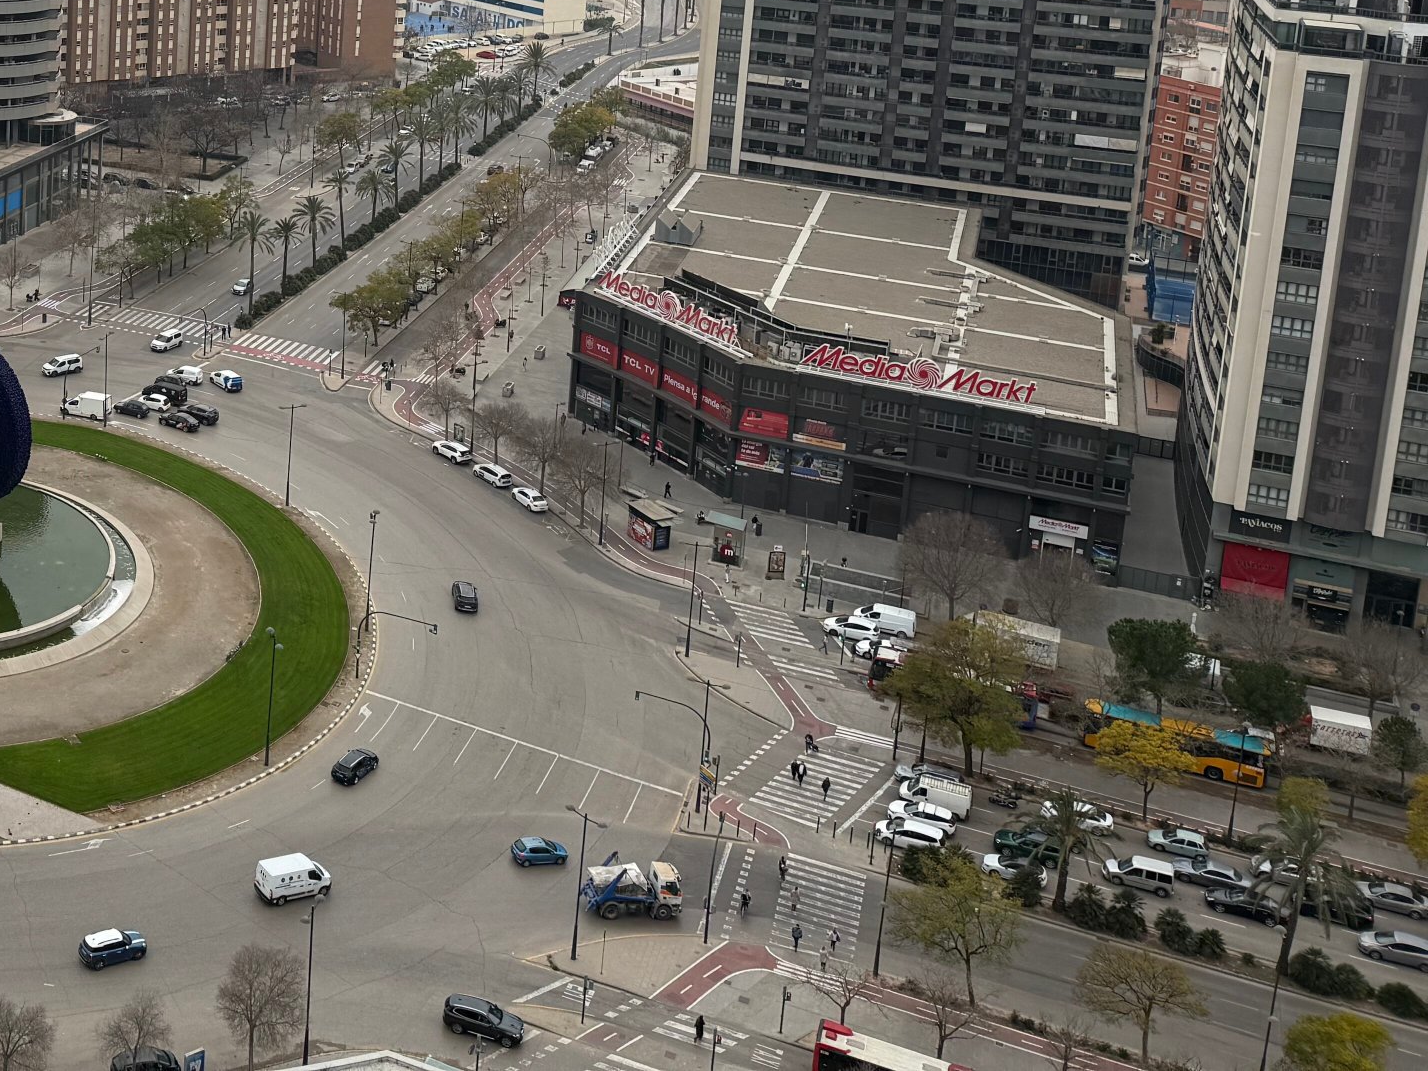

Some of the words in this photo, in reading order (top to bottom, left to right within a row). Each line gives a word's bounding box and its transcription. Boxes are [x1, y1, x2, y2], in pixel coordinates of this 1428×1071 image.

[598, 269, 659, 310] Media
[675, 303, 738, 343] Markt
[596, 343, 611, 355] TCL
[623, 354, 641, 370] TCL
[644, 364, 655, 376] TV
[799, 344, 907, 381] Media
[936, 368, 1037, 403] Markt
[685, 386, 691, 394] a
